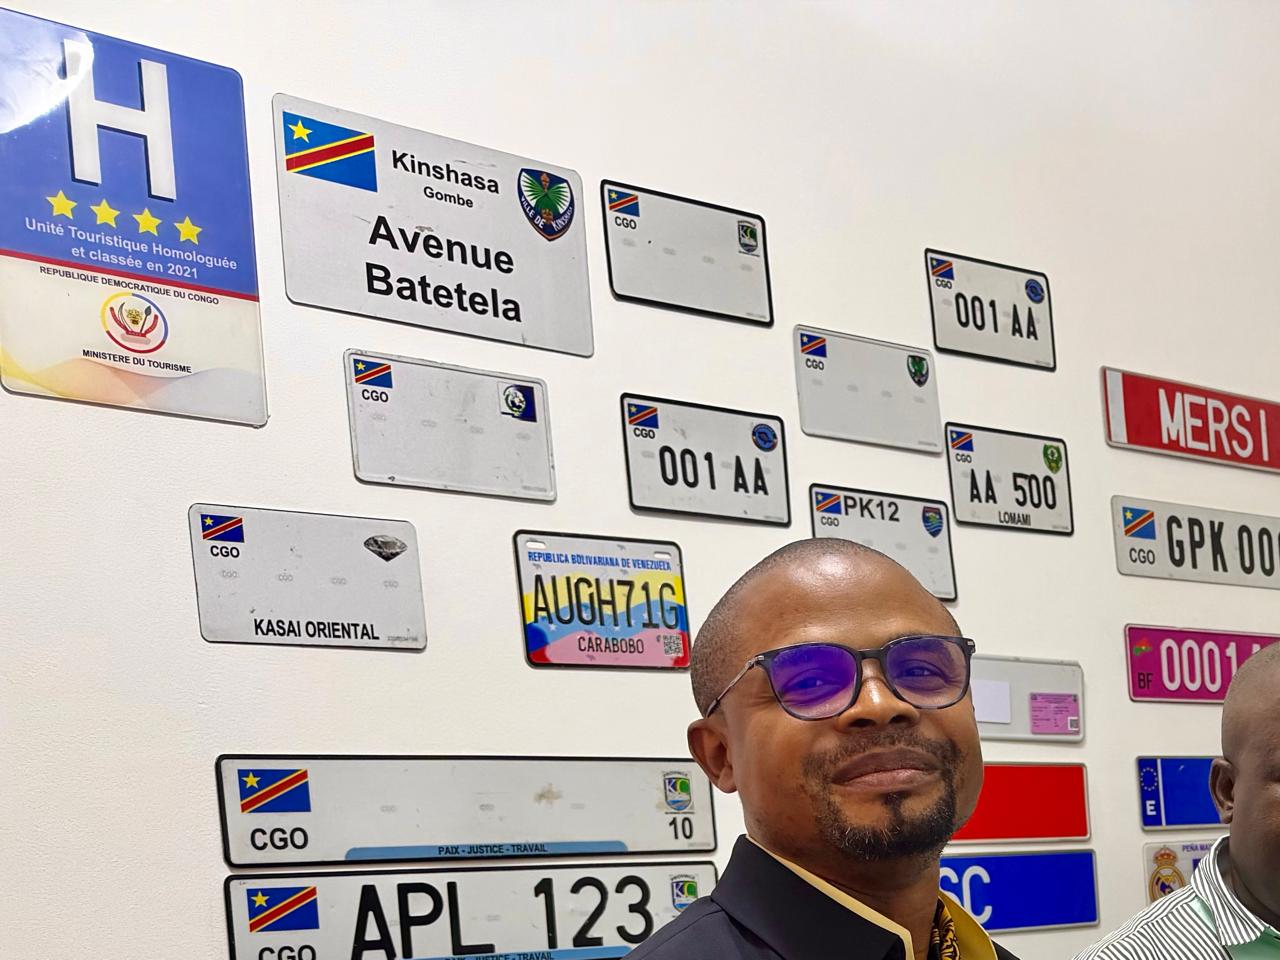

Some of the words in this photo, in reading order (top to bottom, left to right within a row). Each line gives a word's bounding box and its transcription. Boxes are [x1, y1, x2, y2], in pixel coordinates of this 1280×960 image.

[63, 39, 176, 202] H
[392, 149, 500, 194] Kinshasa
[423, 186, 474, 208] Gombe
[520, 195, 535, 218] VILLE
[534, 216, 546, 229] DE
[614, 216, 637, 230] CGO
[25, 217, 64, 236] Unité
[68, 225, 149, 254] Touristique
[152, 241, 237, 271] Homologuée
[368, 215, 514, 275] Avenue
[72, 246, 85, 258] et
[89, 249, 143, 269] classée
[146, 260, 163, 273] en
[167, 262, 198, 280] 2021
[39, 266, 99, 284] REPUBLIQUE
[101, 277, 171, 297] DEMOCRATIQUE
[173, 290, 186, 299] DU
[187, 292, 219, 305] CONGO
[365, 262, 522, 323] Batetela
[935, 278, 953, 290] CGO
[954, 292, 999, 333] 001
[1011, 304, 1039, 340] AA
[82, 349, 131, 365] MINISTERE
[133, 356, 145, 366] DU
[147, 359, 192, 374] TOURISME
[805, 358, 824, 371] CGO
[361, 389, 389, 403] CGO
[633, 427, 656, 440] CGO
[955, 452, 973, 464] CGO
[659, 445, 717, 491] 001
[734, 455, 769, 496] AA
[970, 468, 997, 504] AA
[1012, 472, 1057, 509] 500
[843, 495, 900, 523] PK12
[998, 511, 1031, 526] LOMAMI
[820, 516, 840, 527] CGO
[210, 545, 240, 559] CGO
[1166, 515, 1229, 573] GPK
[528, 551, 570, 565] REPUBLICA
[571, 554, 619, 568] BOLIVARIANA
[621, 558, 631, 569] DE
[632, 558, 671, 571] VENEZUELA
[1129, 547, 1156, 566] CGO
[533, 574, 679, 630] AUGH71G
[254, 618, 301, 638] KASAI
[305, 620, 380, 641] ORIENTAL
[578, 636, 644, 654] CARABOBO
[1137, 672, 1154, 690] BF
[1146, 800, 1157, 816] E
[250, 827, 309, 851] CGO
[668, 817, 694, 840] 10
[438, 846, 459, 855] PAIX
[467, 845, 504, 855] JUSTICE
[511, 843, 548, 853] TRAVAIL
[533, 875, 654, 951] 123
